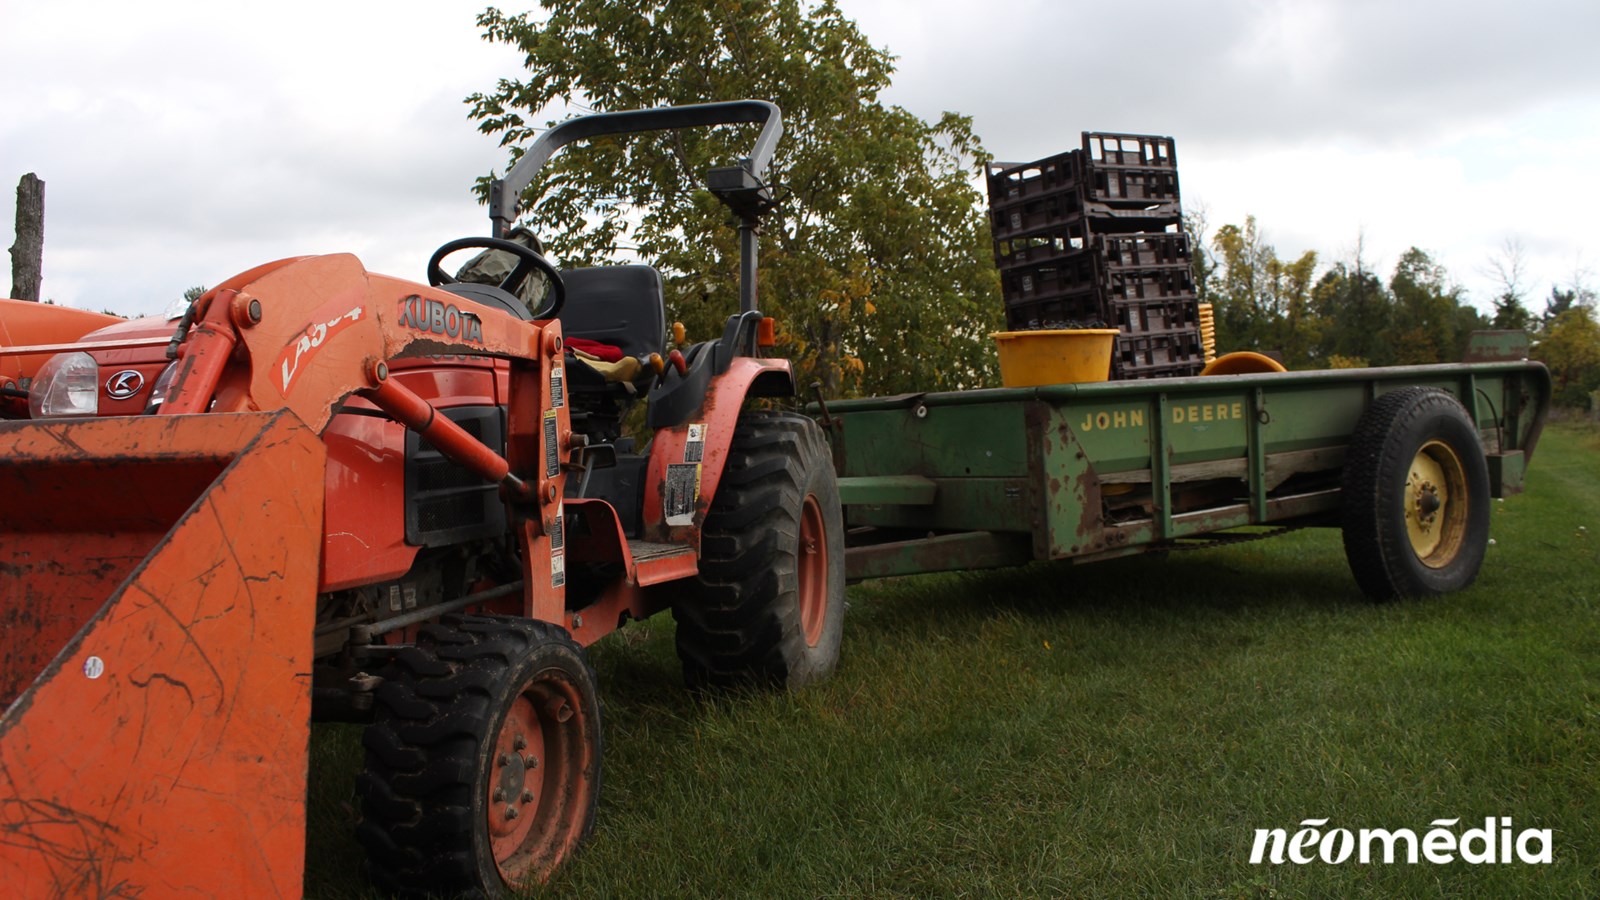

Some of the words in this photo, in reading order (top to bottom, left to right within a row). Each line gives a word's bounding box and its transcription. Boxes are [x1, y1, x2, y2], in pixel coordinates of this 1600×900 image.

[399, 295, 483, 344] KUBOTA
[1081, 409, 1143, 432] JOHN
[1172, 403, 1242, 424] DEERE
